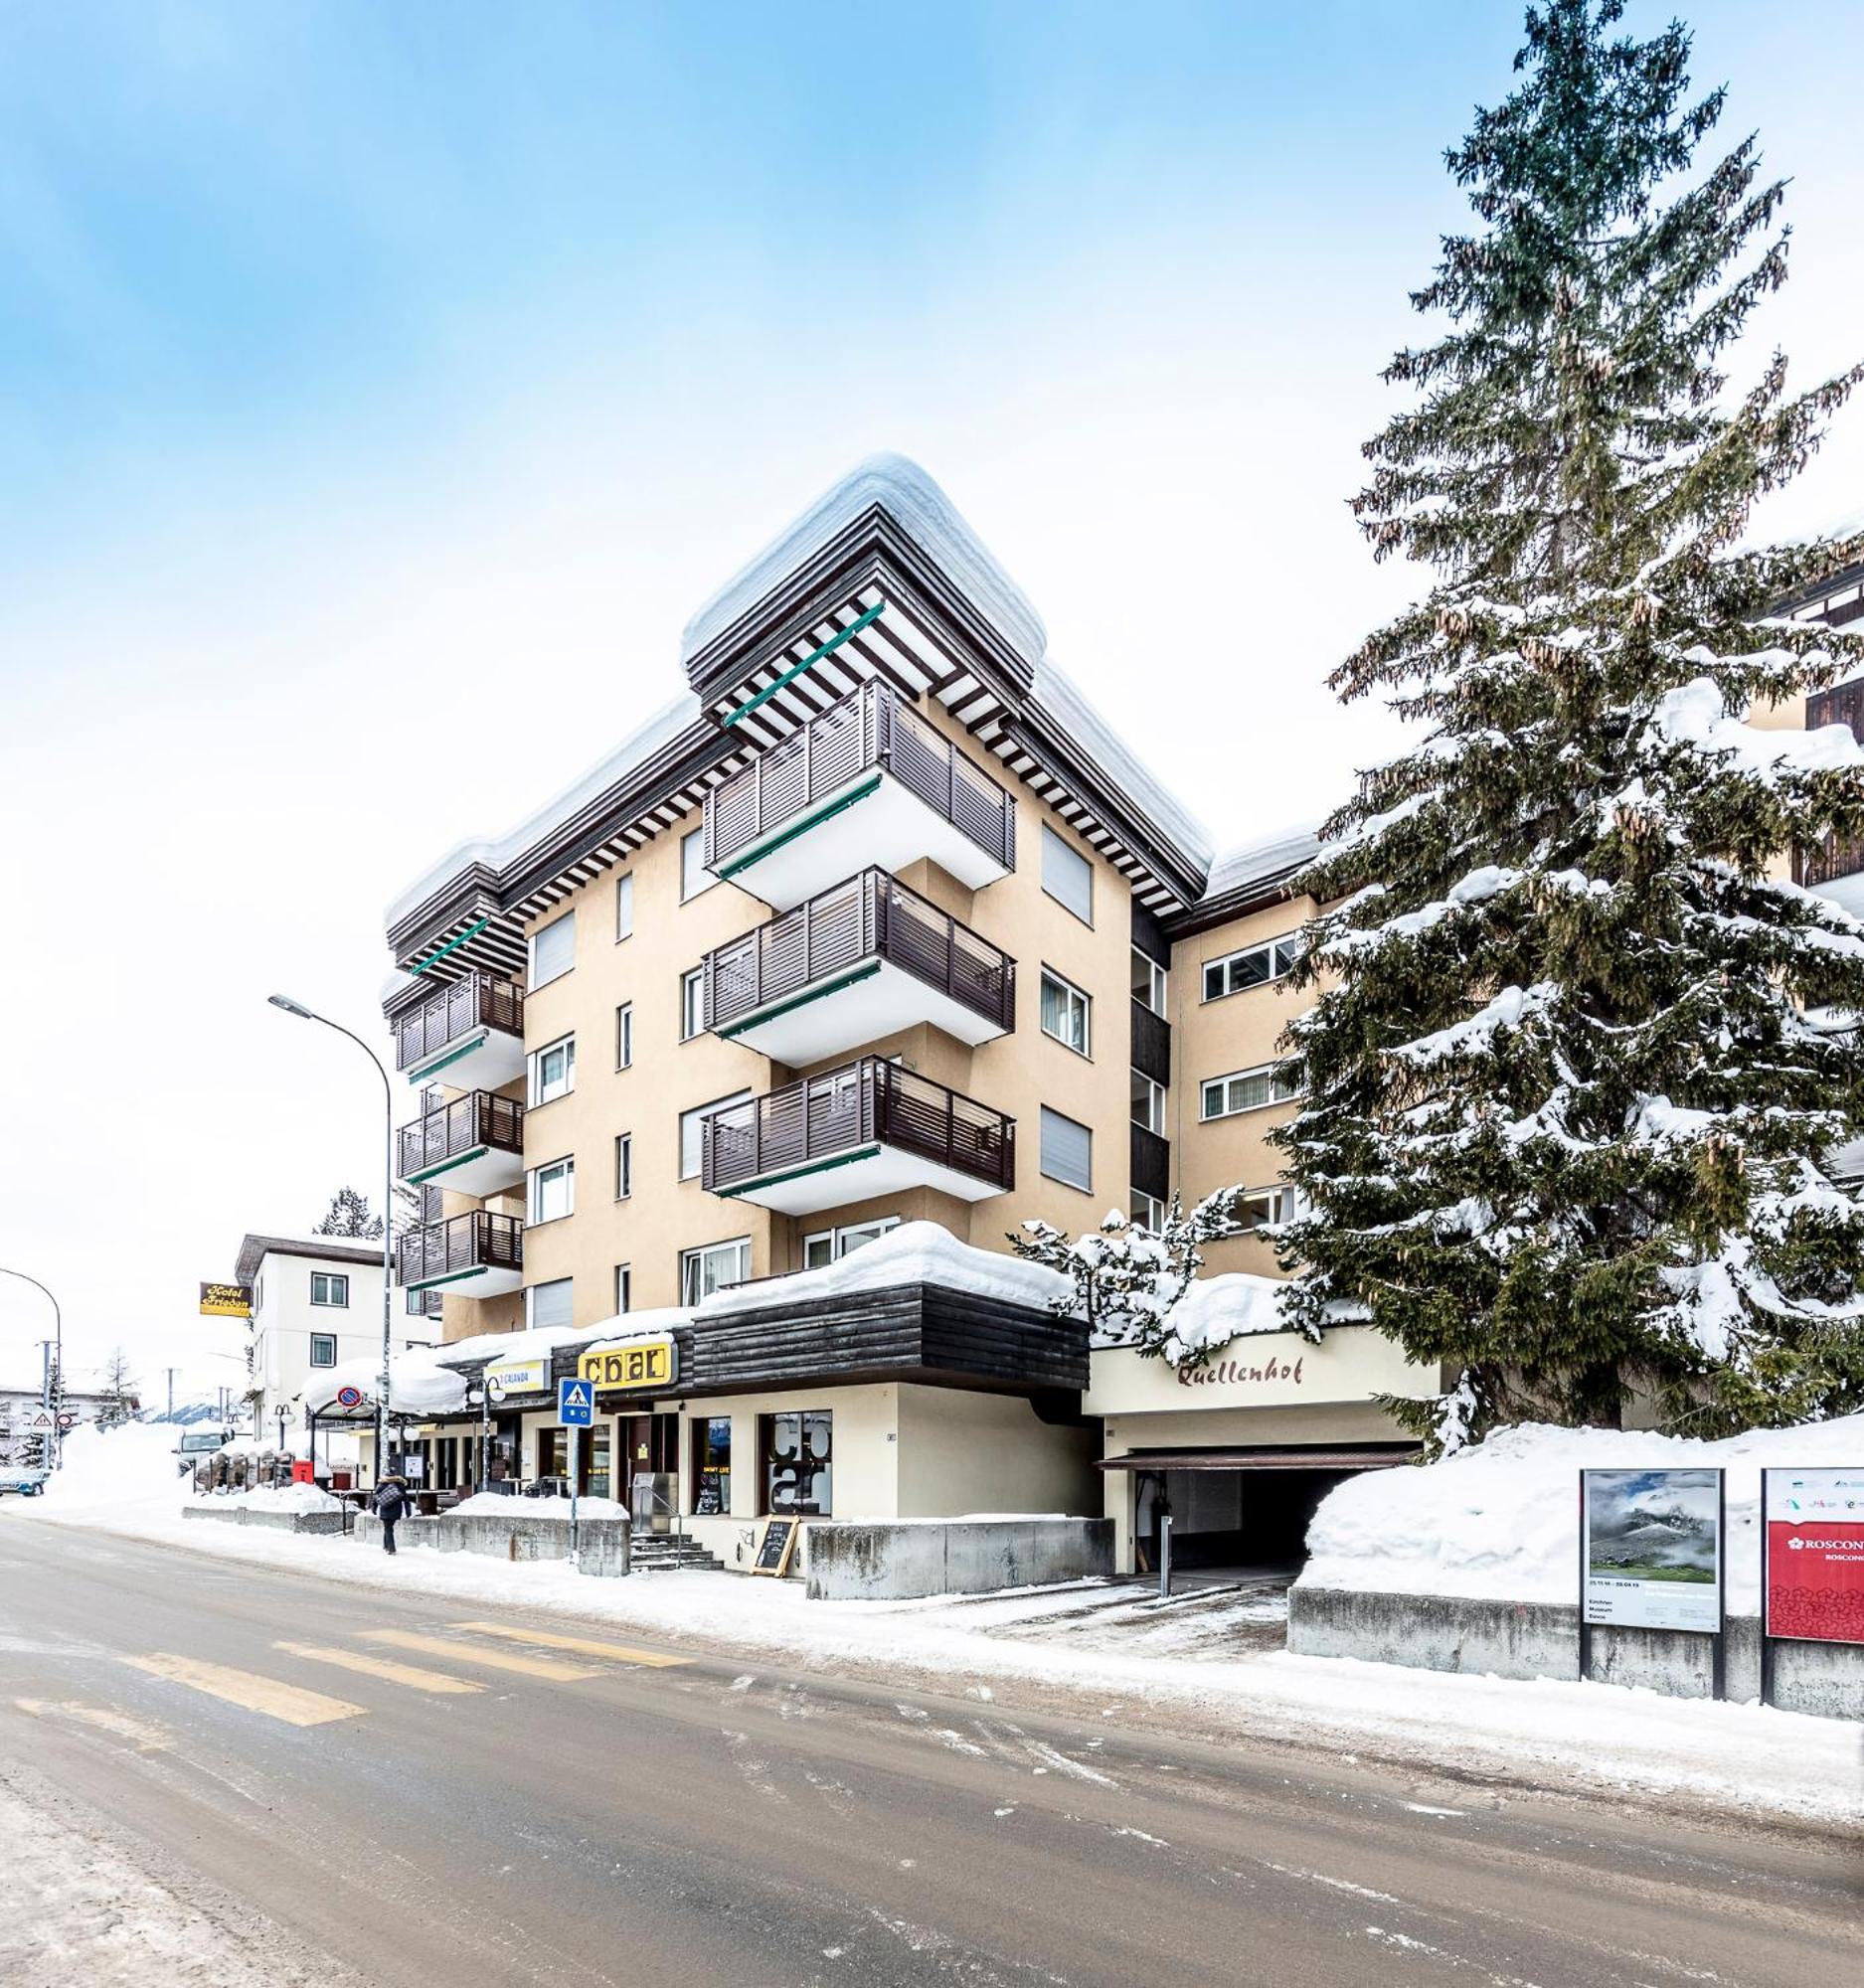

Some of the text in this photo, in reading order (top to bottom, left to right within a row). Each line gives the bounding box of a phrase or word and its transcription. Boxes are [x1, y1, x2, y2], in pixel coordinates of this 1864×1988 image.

[202, 1295, 249, 1308] Frieden
[207, 1285, 244, 1297] Hotel
[585, 1348, 663, 1384] cbar
[1178, 1356, 1303, 1387] Quellenhof
